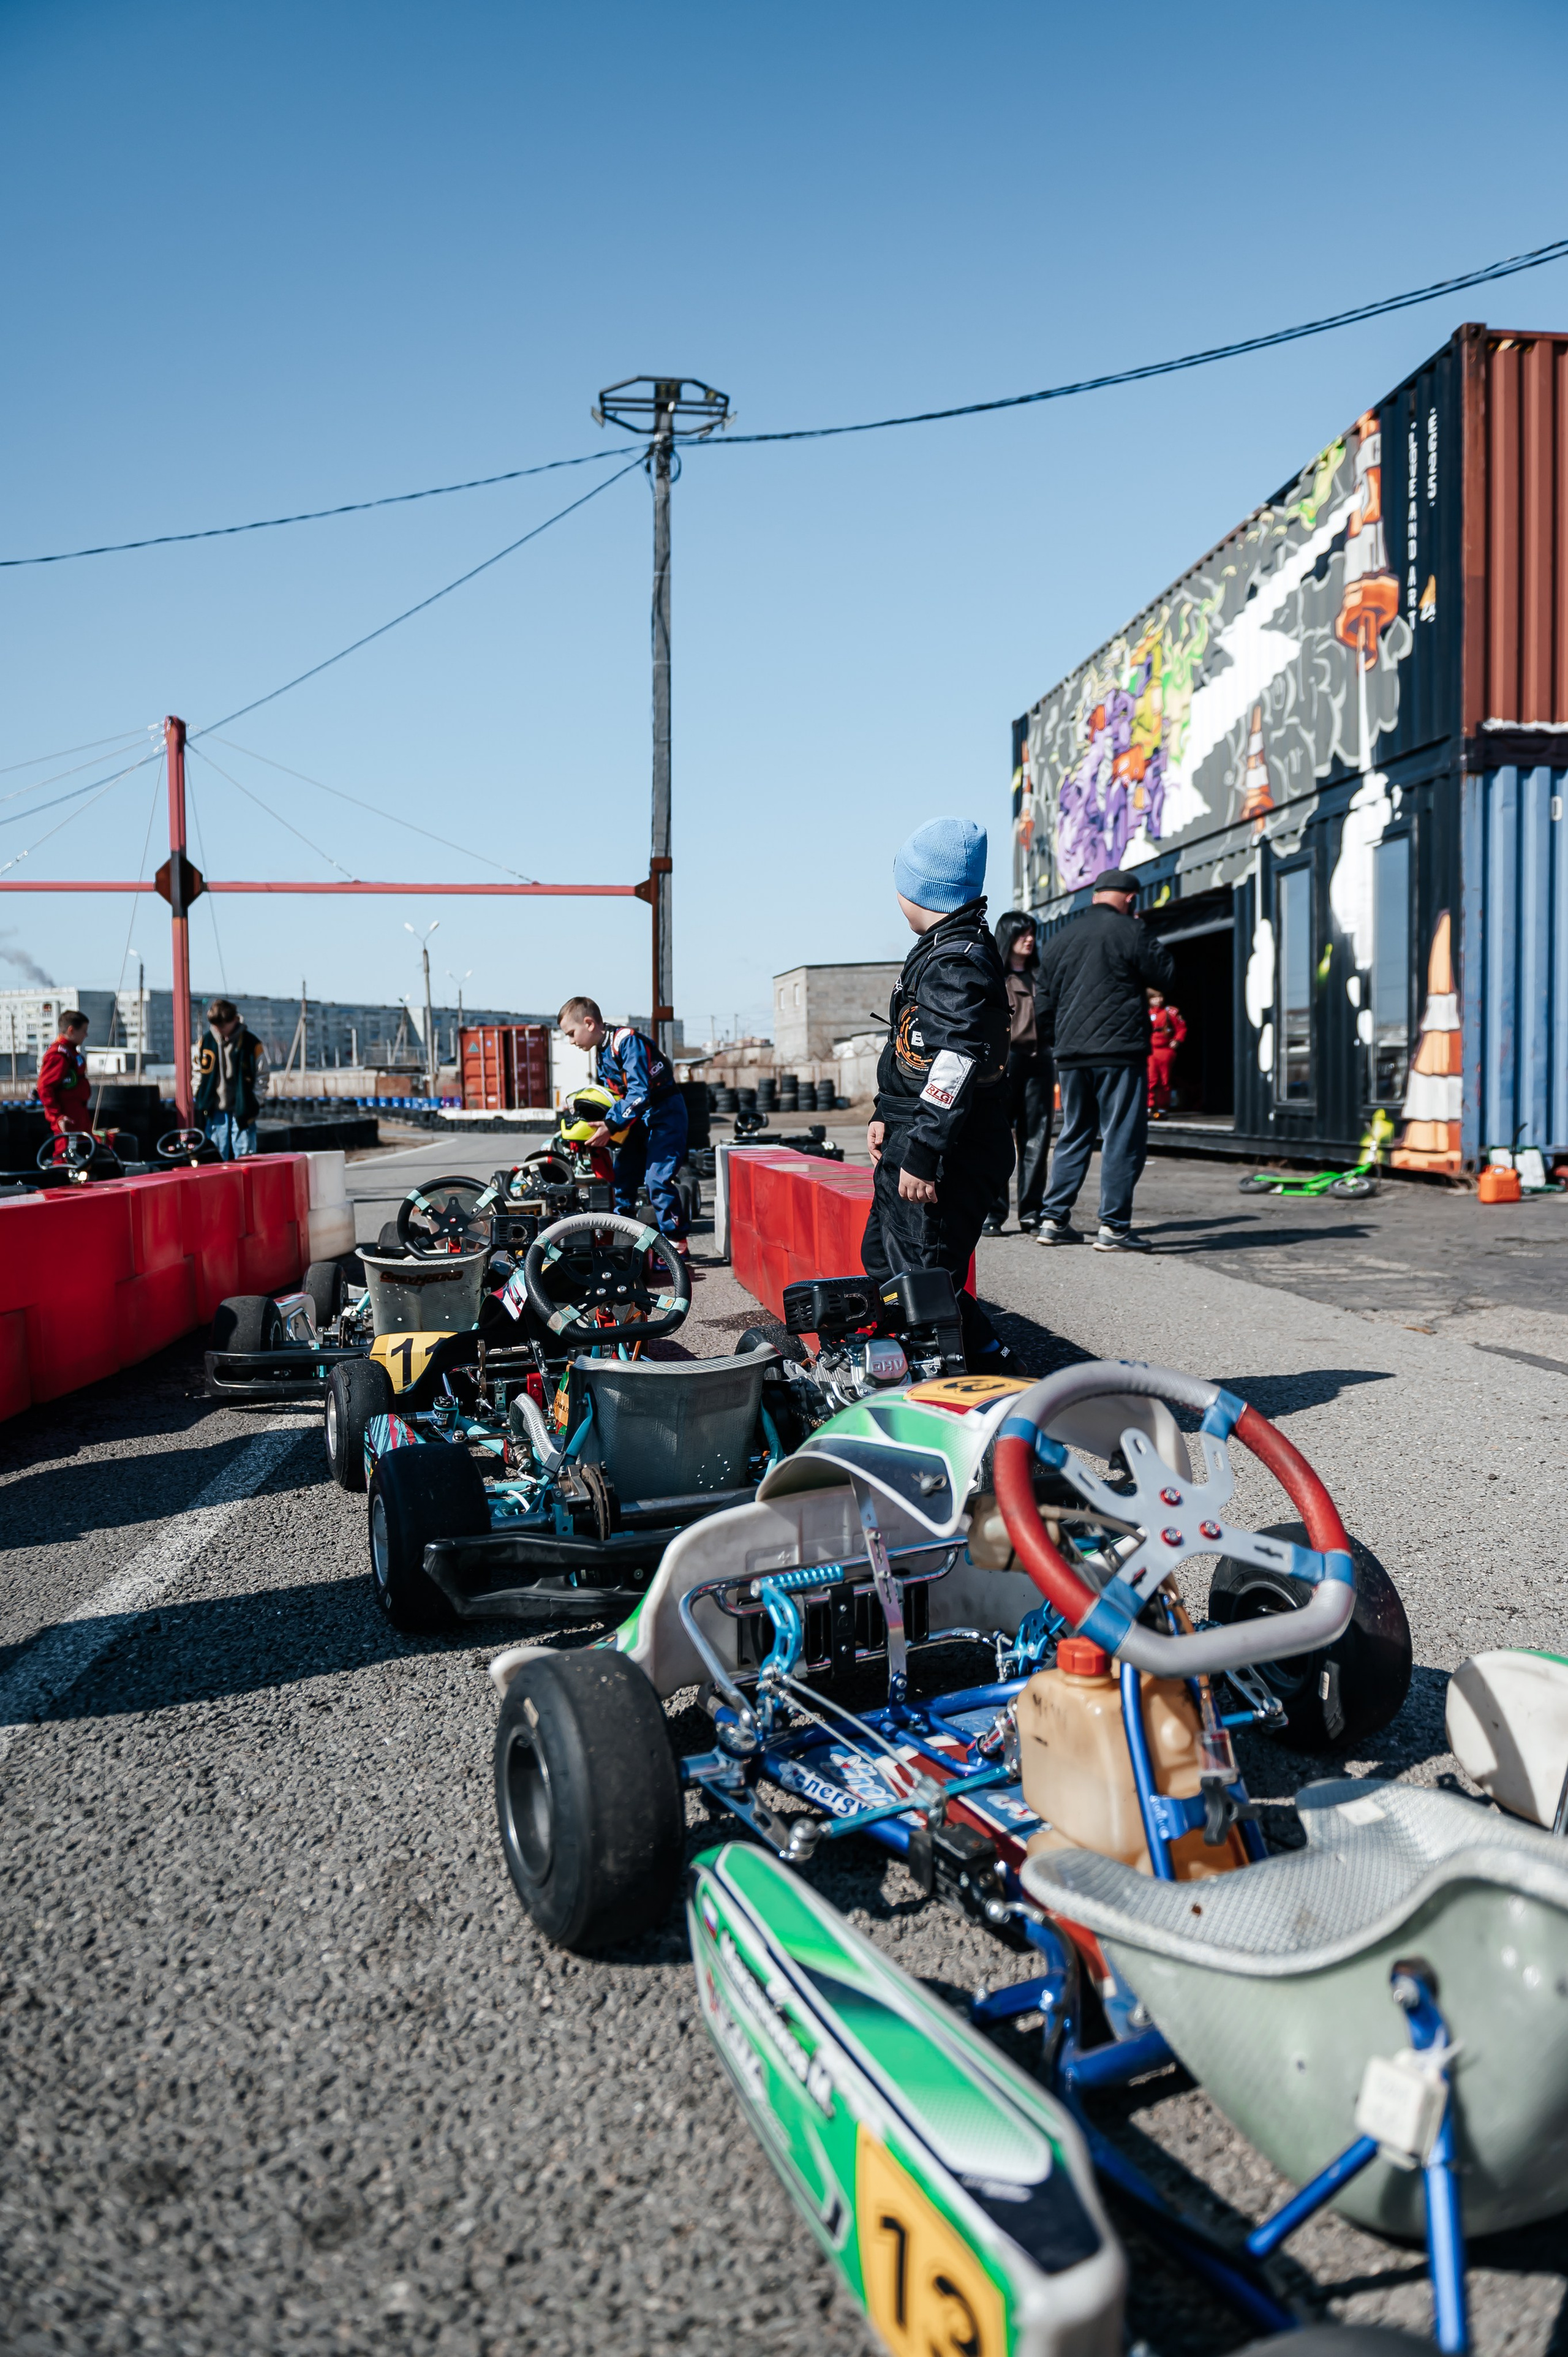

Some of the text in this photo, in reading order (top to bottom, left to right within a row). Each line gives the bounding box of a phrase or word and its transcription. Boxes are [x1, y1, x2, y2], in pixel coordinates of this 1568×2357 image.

[1408, 431, 1418, 631] LOVE AND ART
[872, 1359, 904, 1372] OHV
